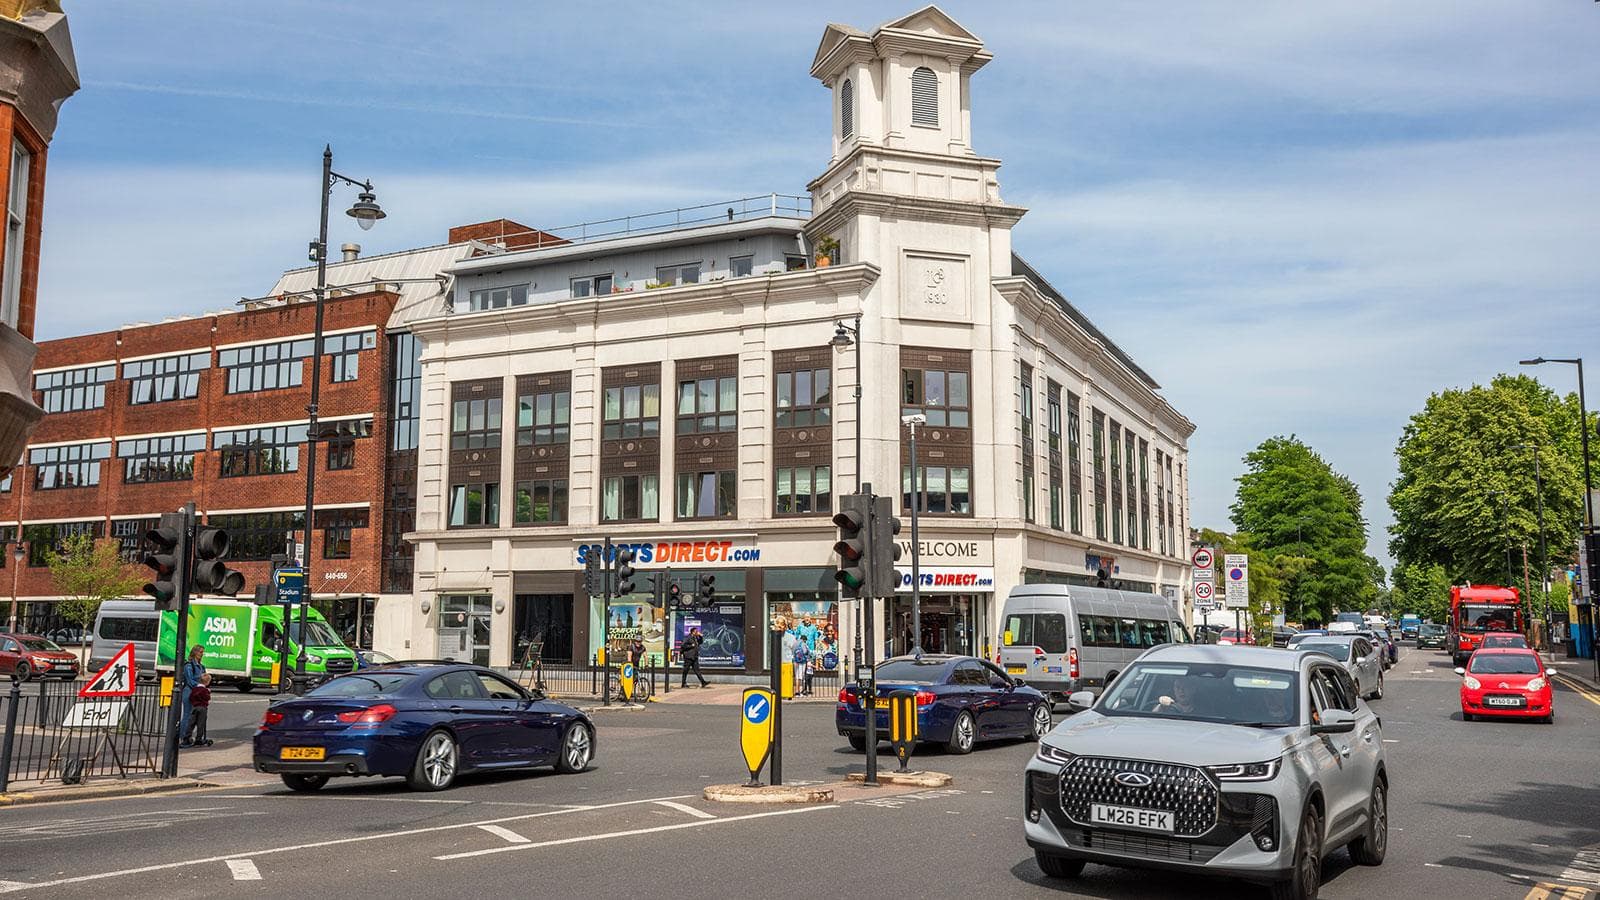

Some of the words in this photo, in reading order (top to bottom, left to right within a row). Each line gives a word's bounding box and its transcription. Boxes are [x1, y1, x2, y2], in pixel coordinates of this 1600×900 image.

[901, 541, 978, 557] WELCOME
[1198, 586, 1210, 594] 20
[204, 617, 237, 634] ASDA
[206, 634, 235, 647] .com
[83, 708, 111, 720] End
[1098, 807, 1135, 824] LM26
[1139, 812, 1167, 828] EFK
